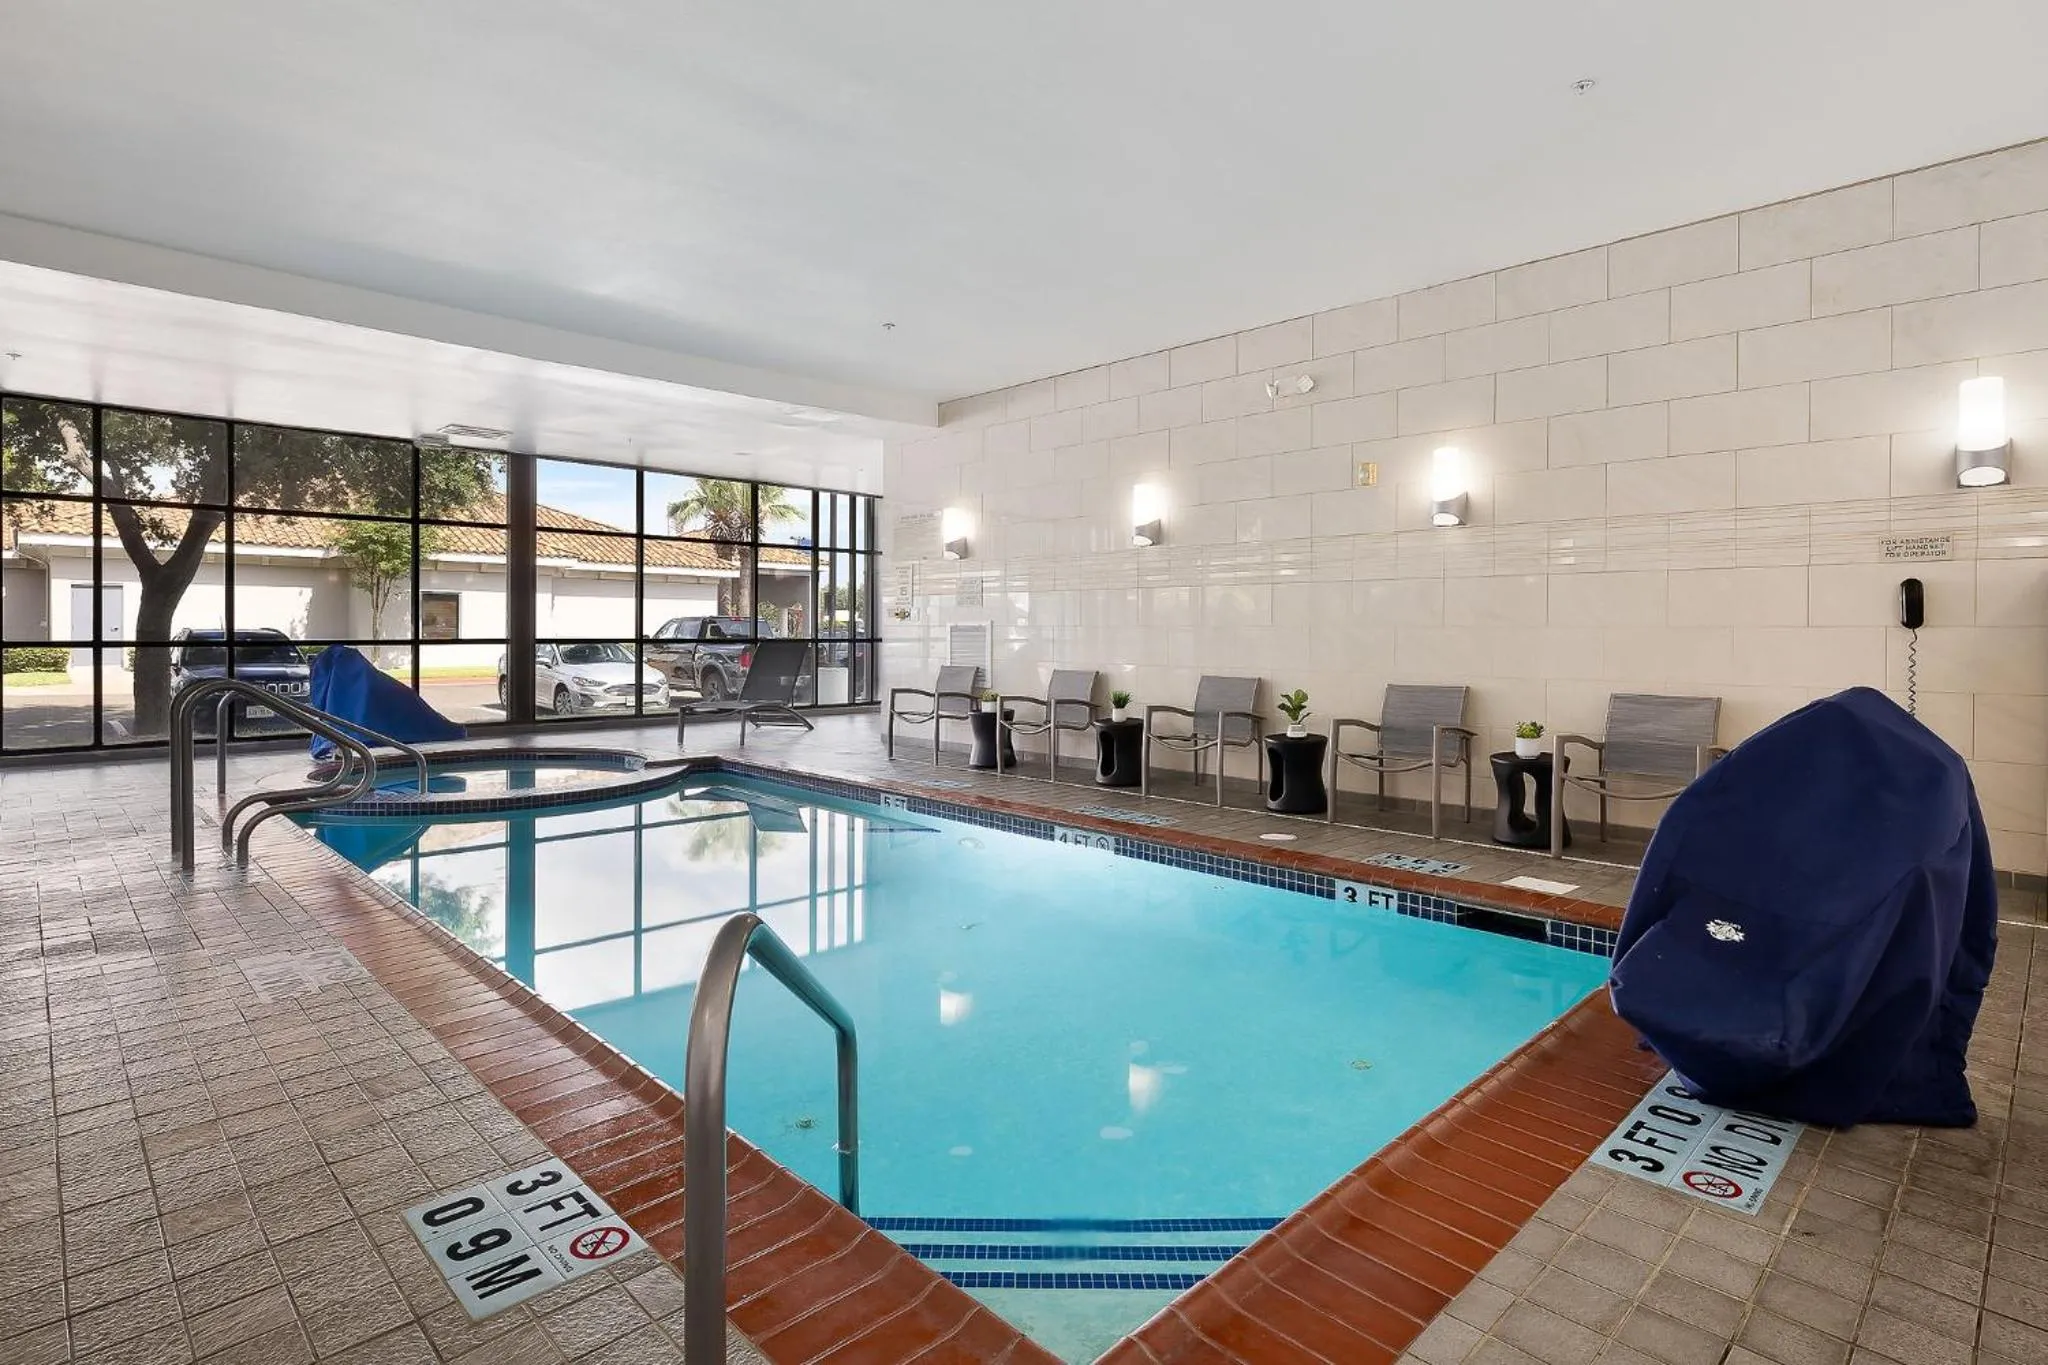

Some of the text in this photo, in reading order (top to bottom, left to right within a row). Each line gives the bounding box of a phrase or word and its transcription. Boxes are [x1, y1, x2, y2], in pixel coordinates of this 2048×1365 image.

[1903, 550, 1947, 558] OPERATOR
[1073, 833, 1092, 849] FT
[1343, 886, 1395, 911] 3 FT
[1700, 1145, 1769, 1180] NO
